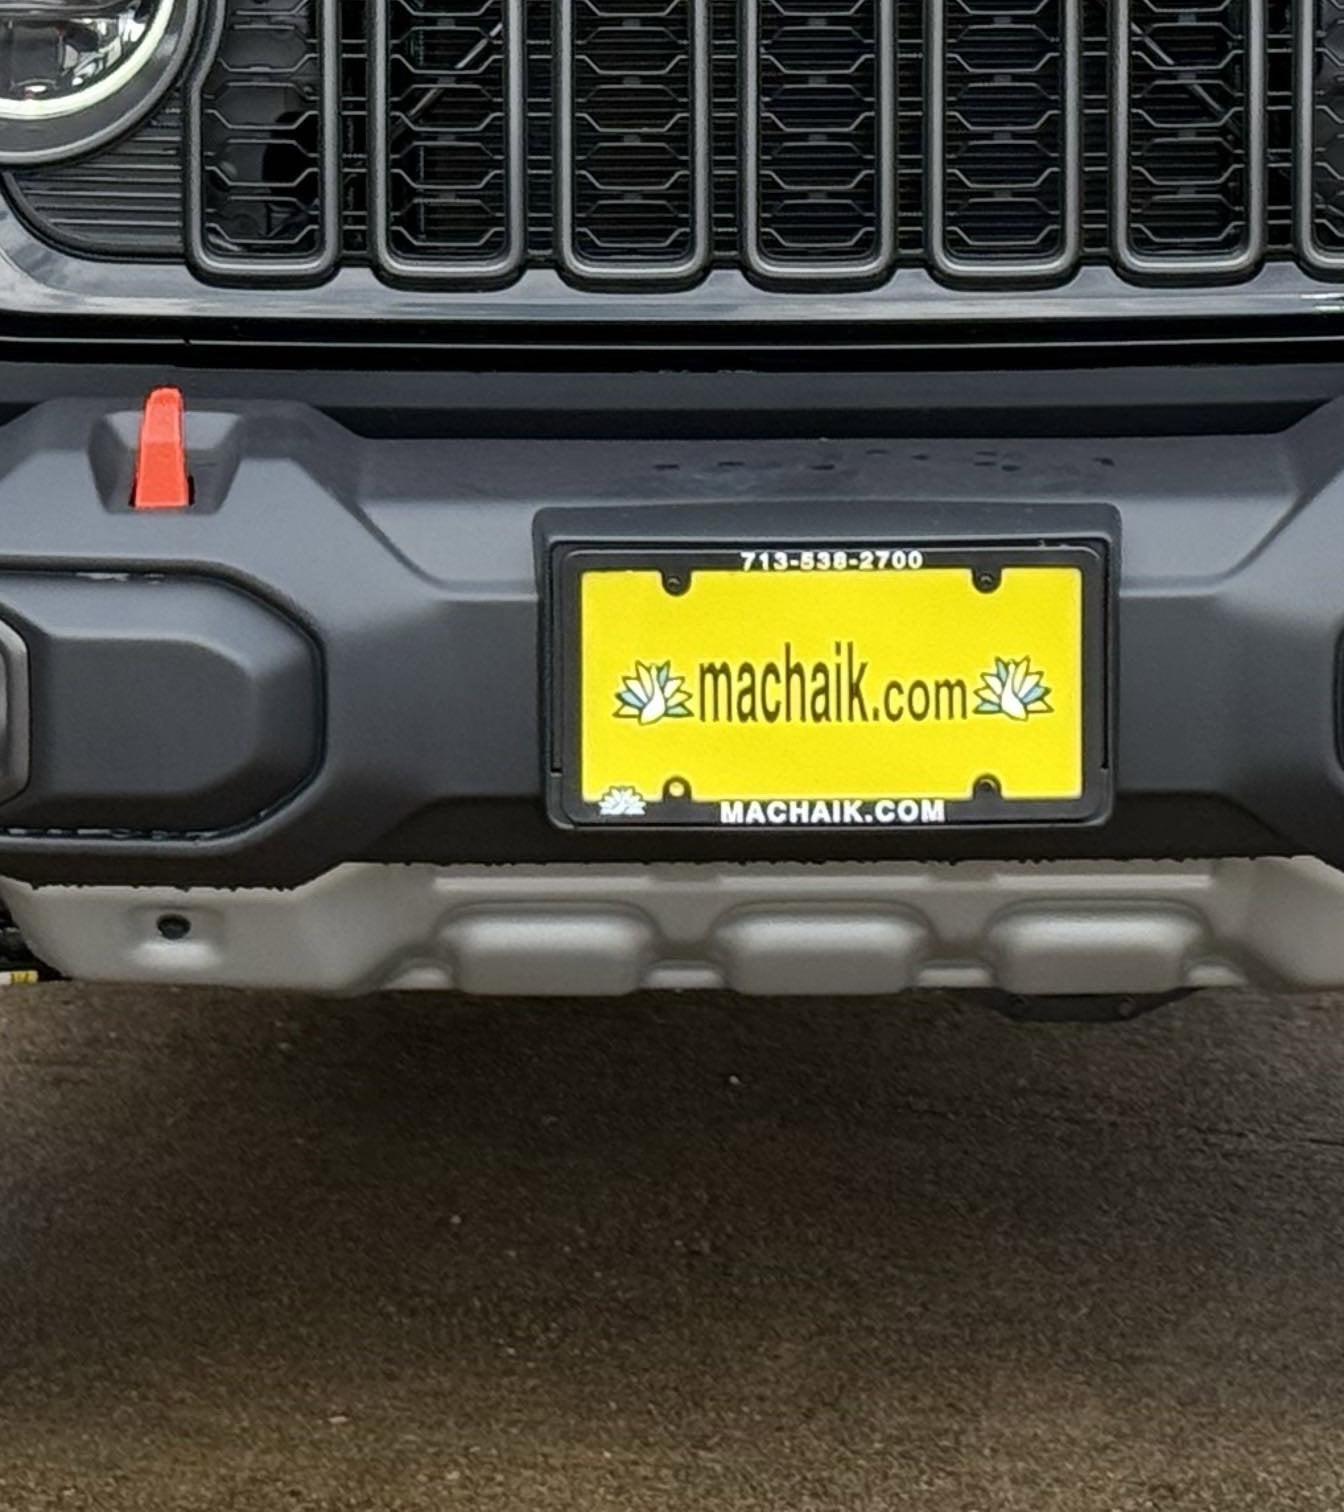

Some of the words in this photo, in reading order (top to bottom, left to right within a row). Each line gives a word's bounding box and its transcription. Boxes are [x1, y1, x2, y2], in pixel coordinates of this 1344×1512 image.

[739, 550, 924, 571] 713-538-2700
[698, 641, 968, 723] machaik.com
[720, 798, 945, 824] MACHAIK.COM
